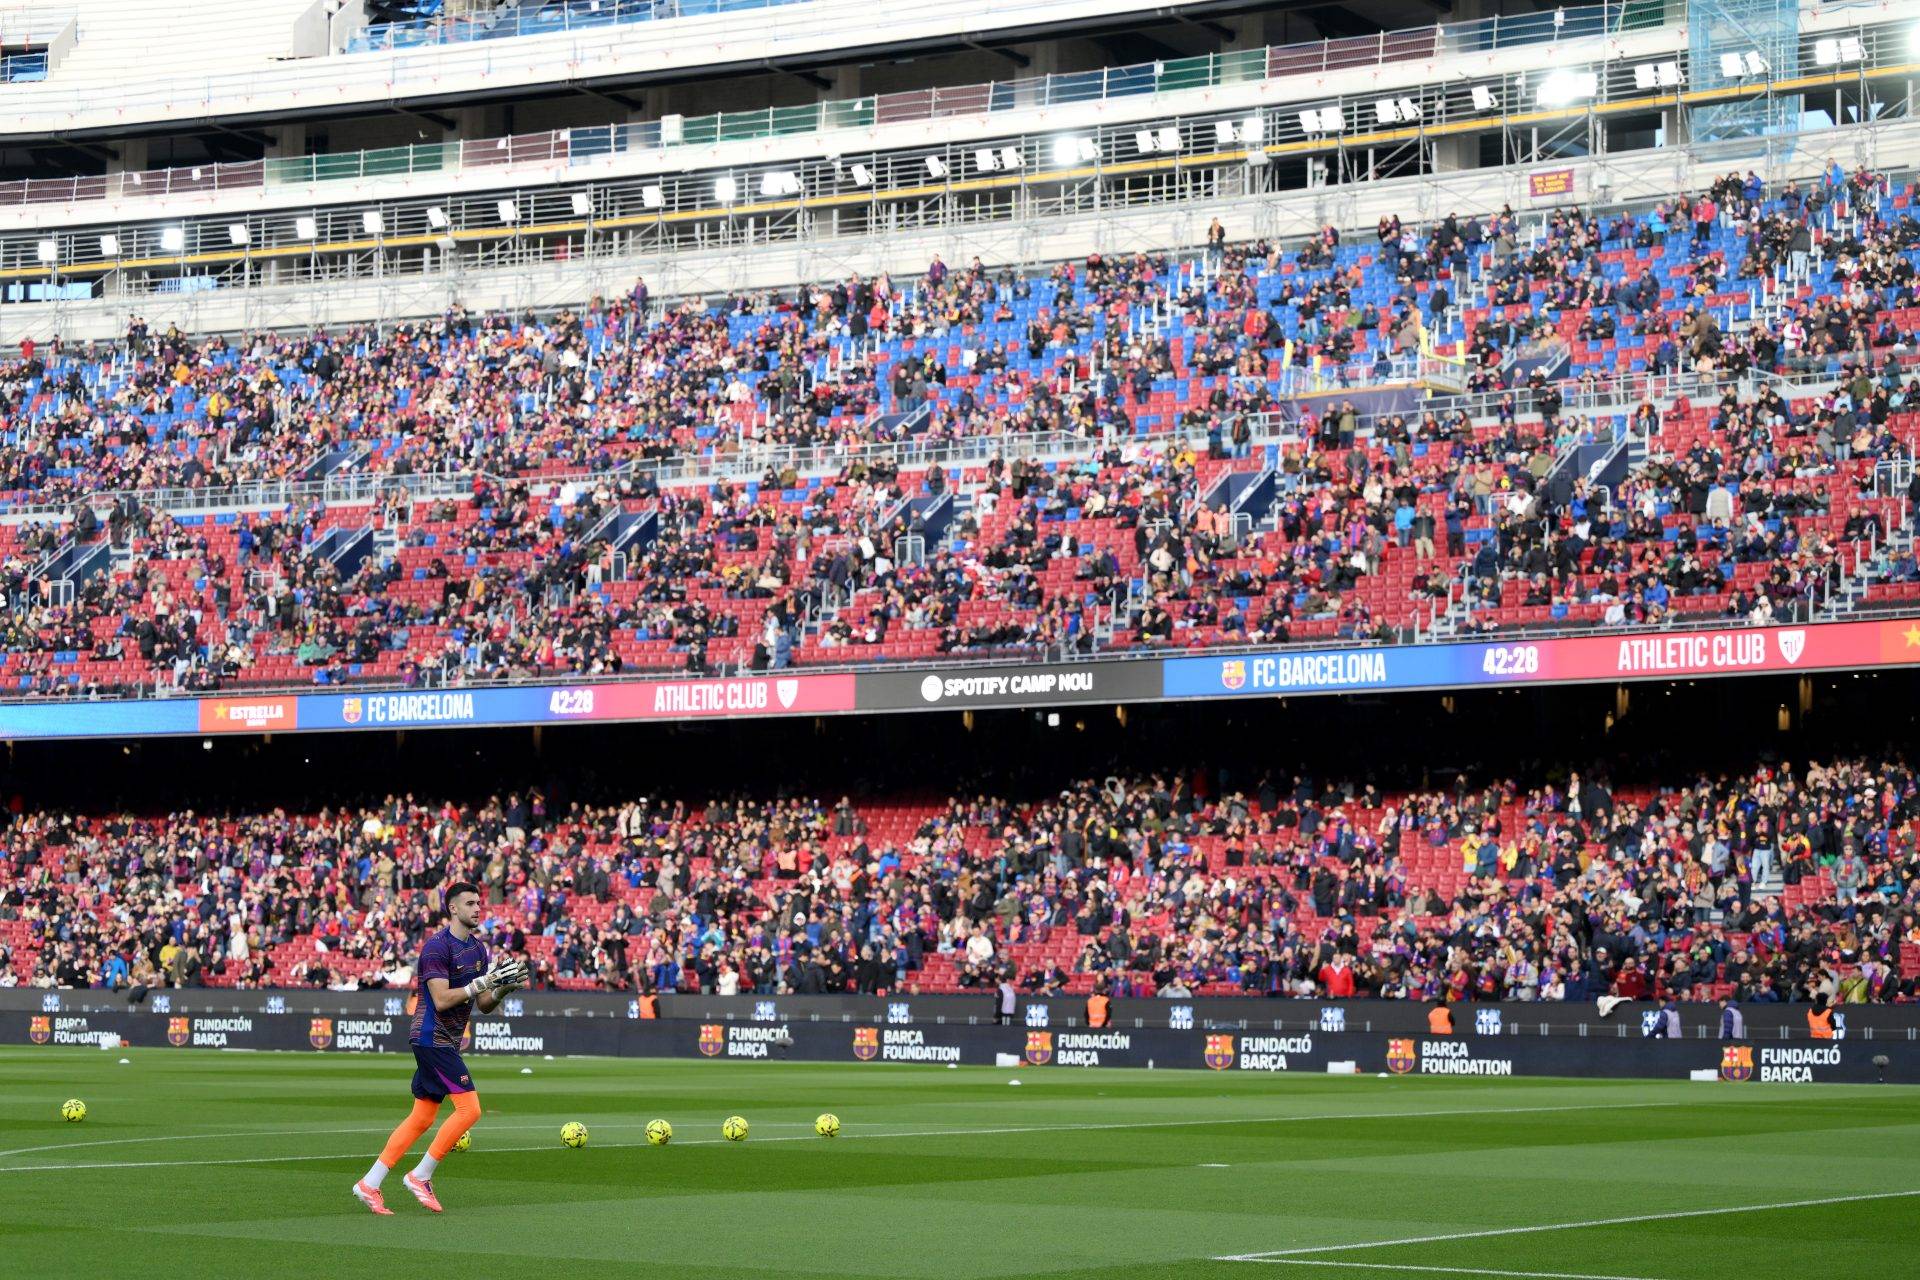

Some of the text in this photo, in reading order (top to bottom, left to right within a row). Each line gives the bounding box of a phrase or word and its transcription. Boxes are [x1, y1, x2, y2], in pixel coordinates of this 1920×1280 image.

[1483, 646, 1538, 675] 42:28
[1618, 633, 1765, 670] ATHLETIC CLUB
[1253, 653, 1385, 687] FC BARCELONA
[945, 673, 1092, 697] SPOTIFY CAMP NOU
[550, 689, 593, 714] 42:28
[655, 681, 767, 711] ATHLETIC CLUB
[230, 705, 283, 720] ESTRELLA
[368, 693, 474, 721] FC BARCELONA
[194, 1015, 252, 1031] FUNDACIÓN
[337, 1018, 392, 1035] FUNDACIÓ
[475, 1022, 511, 1038] BARÇA
[193, 1032, 228, 1047] BARÇA
[337, 1034, 373, 1051] BARÇA
[475, 1036, 544, 1051] FOUNDATION
[884, 1030, 924, 1047] BARÇA
[1058, 1032, 1130, 1050] FUNDACIÓN
[1241, 1034, 1311, 1053] FUNDACIÓ
[728, 1041, 768, 1058] BARÇA
[883, 1045, 960, 1061] FOUNDATION
[1422, 1041, 1468, 1059] BARÇA
[1762, 1045, 1841, 1064] FUNDACIÓ
[1058, 1051, 1098, 1068] BARÇA
[1241, 1054, 1288, 1072] BARÇA
[1422, 1057, 1511, 1076] FOUNDATION
[1761, 1066, 1812, 1084] BARÇA
